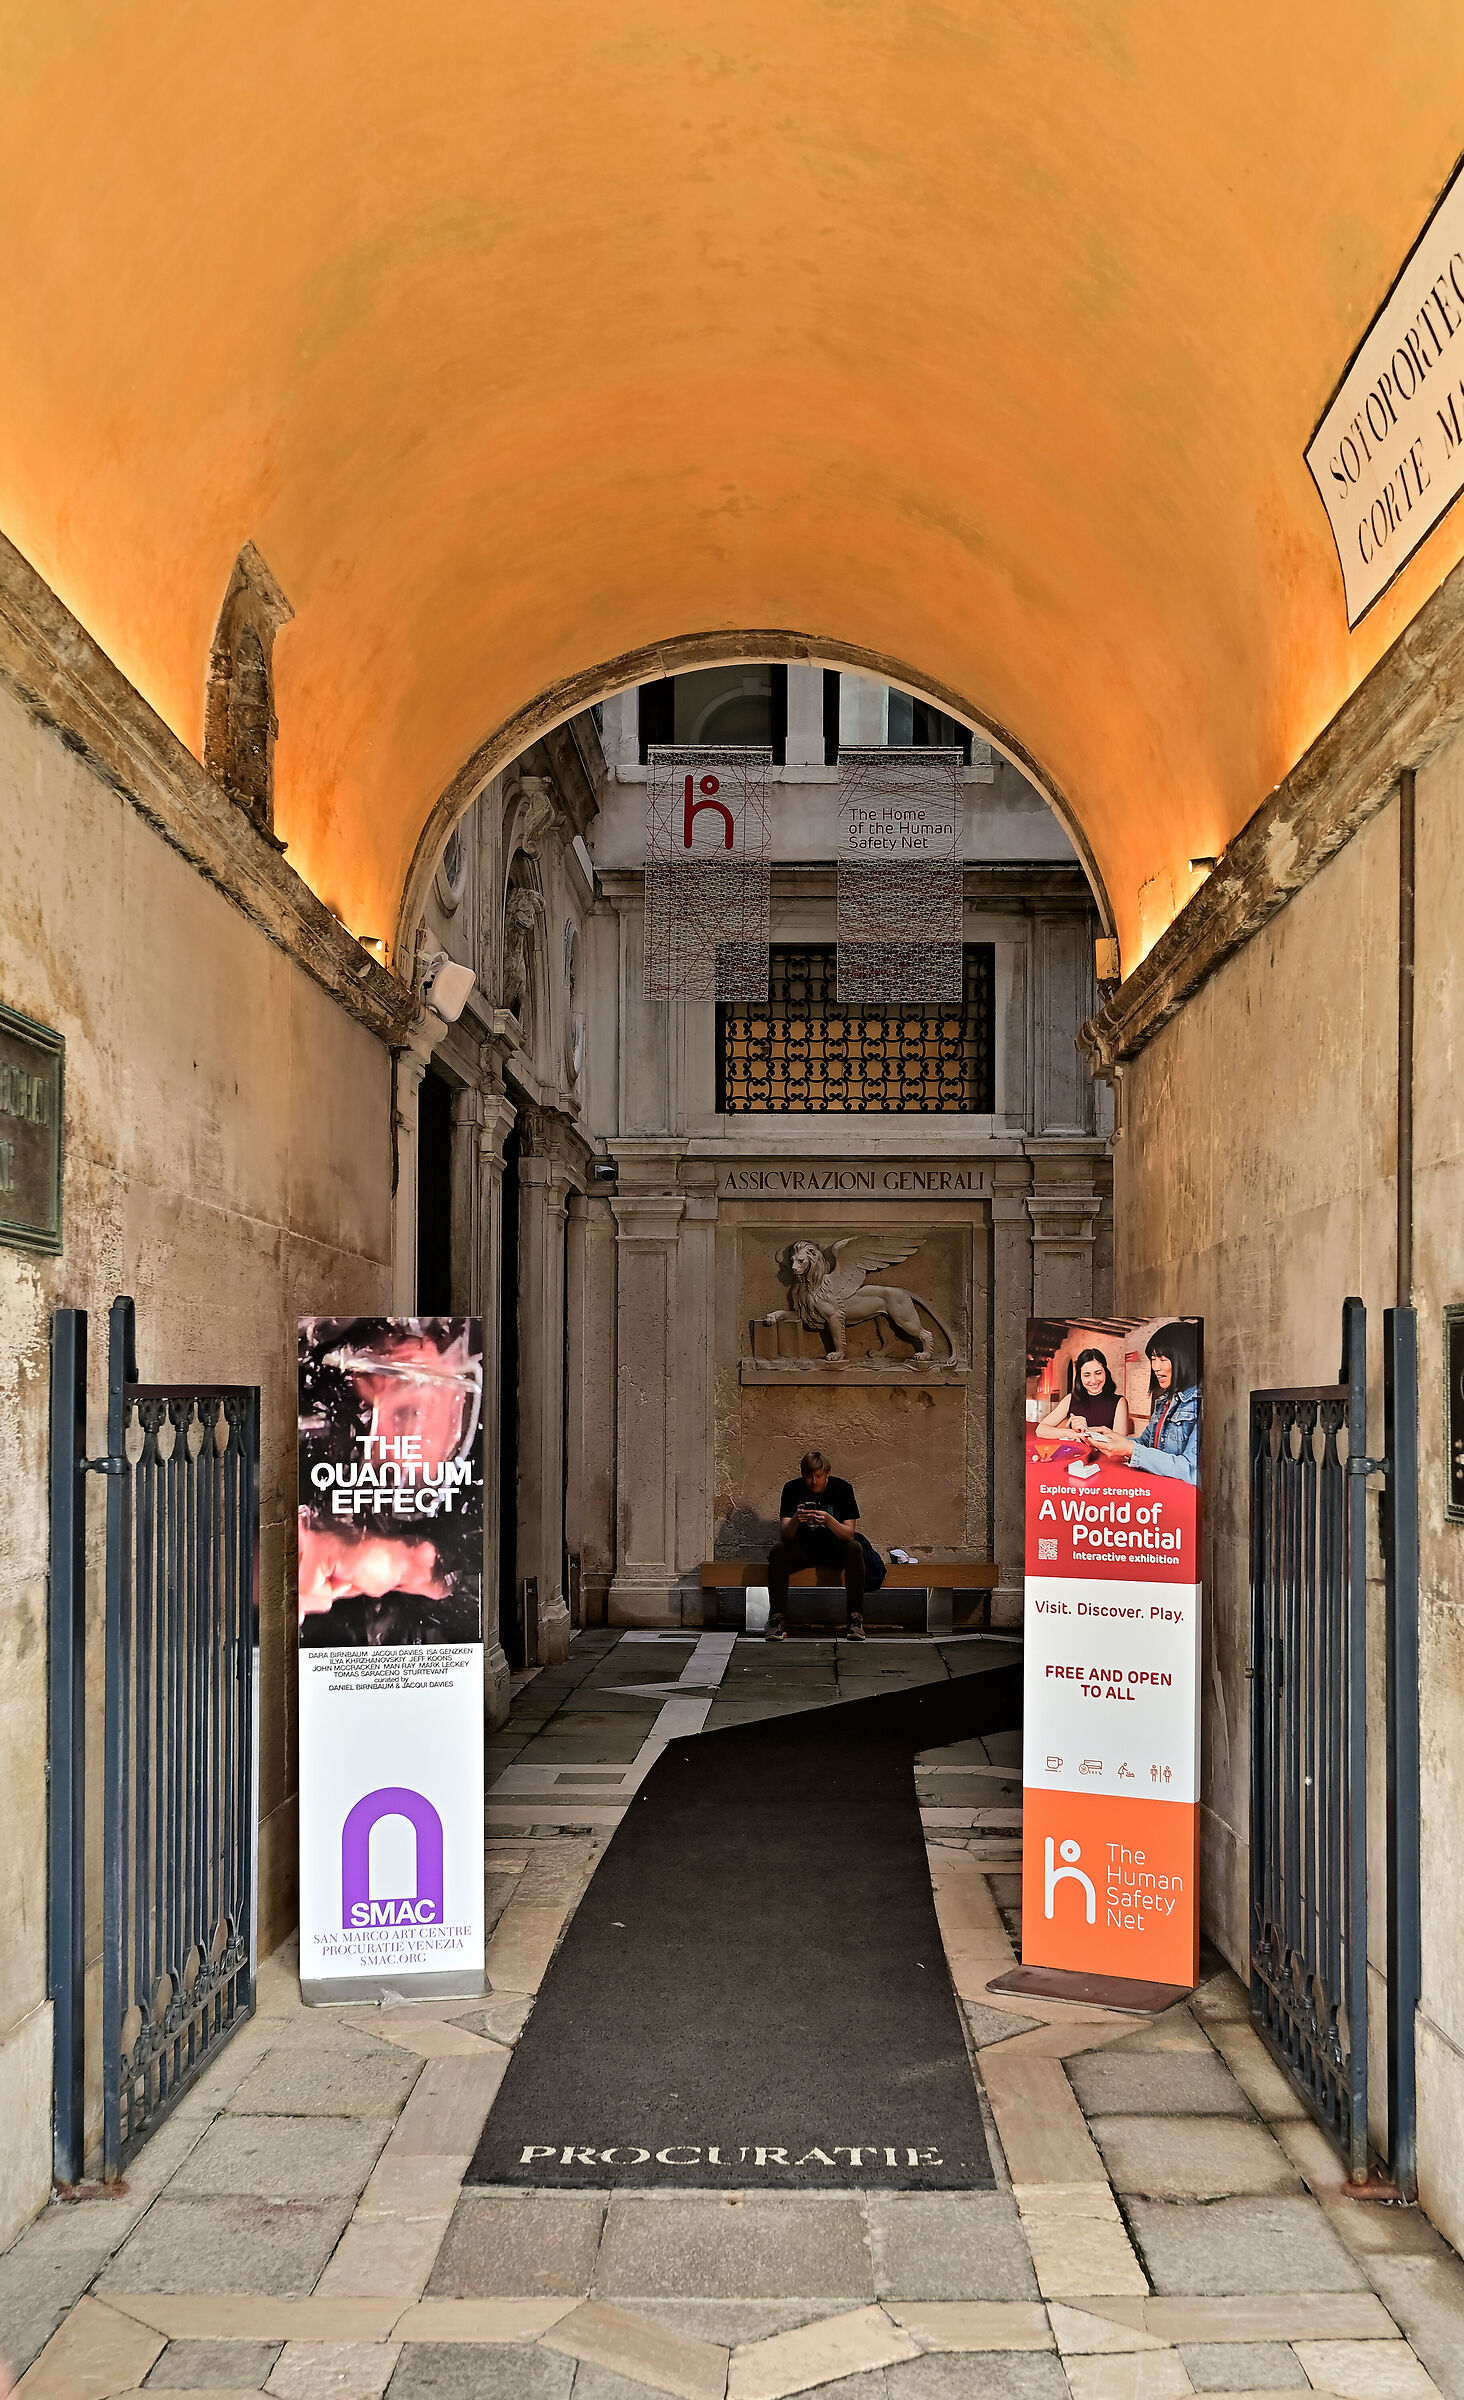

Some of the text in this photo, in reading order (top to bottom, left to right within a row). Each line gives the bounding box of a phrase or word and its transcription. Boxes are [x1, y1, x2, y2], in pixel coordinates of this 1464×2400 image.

[1357, 436, 1431, 564] CORTE
[849, 808, 926, 820] The Home
[849, 822, 953, 834] of the Human
[849, 836, 929, 851] Safety Net
[724, 1171, 984, 1190] ASSICVRAZIONI GENERALI
[356, 1435, 422, 1460] THE
[310, 1460, 473, 1491] QUANTUM
[331, 1487, 460, 1515] EFFECT
[1040, 1485, 1151, 1498] Explore your strengths
[1038, 1499, 1163, 1525] A World of
[1072, 1524, 1182, 1550] Potential
[1072, 1551, 1180, 1565] Interactive exhibition
[1035, 1600, 1184, 1624] Visit. Discover. Play.
[1045, 1665, 1172, 1686] FREE AND OPEN
[1080, 1684, 1136, 1701] TO ALL
[1105, 1842, 1146, 1867] The
[1106, 1865, 1183, 1892] Human
[350, 1899, 436, 1927] SMAC
[1106, 1887, 1176, 1917] Safety
[1106, 1909, 1145, 1931] Net
[313, 1925, 472, 1944] SAN MARCO ART CENTRE
[322, 1938, 464, 1956] PROCURATIE VENEZIA
[360, 1952, 427, 1966] SMAC.ORG
[518, 2145, 944, 2167] PROCURATIE
